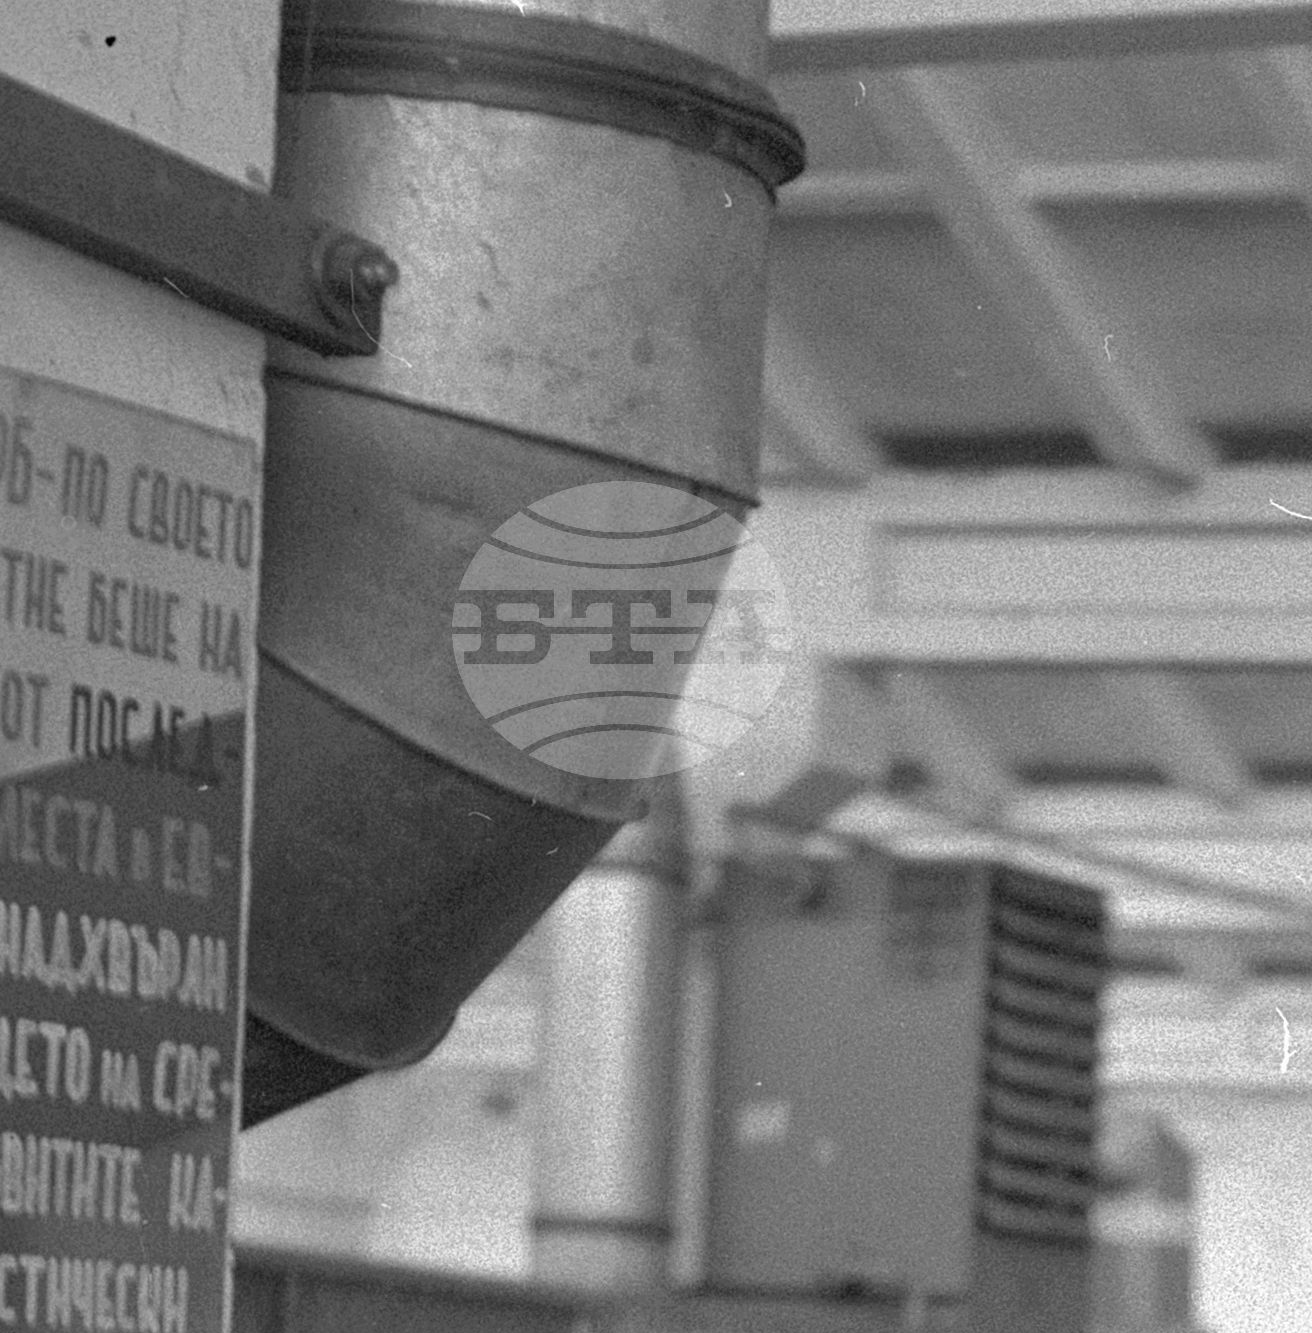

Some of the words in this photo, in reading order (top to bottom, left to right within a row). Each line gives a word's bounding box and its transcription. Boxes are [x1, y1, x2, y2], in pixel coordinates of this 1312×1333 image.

[61, 443, 109, 529] ПО
[128, 463, 254, 570] СВОЕТО
[86, 569, 181, 665] БЕШЕ
[199, 599, 243, 680] НА
[153, 1039, 233, 1121] СРЕ-
